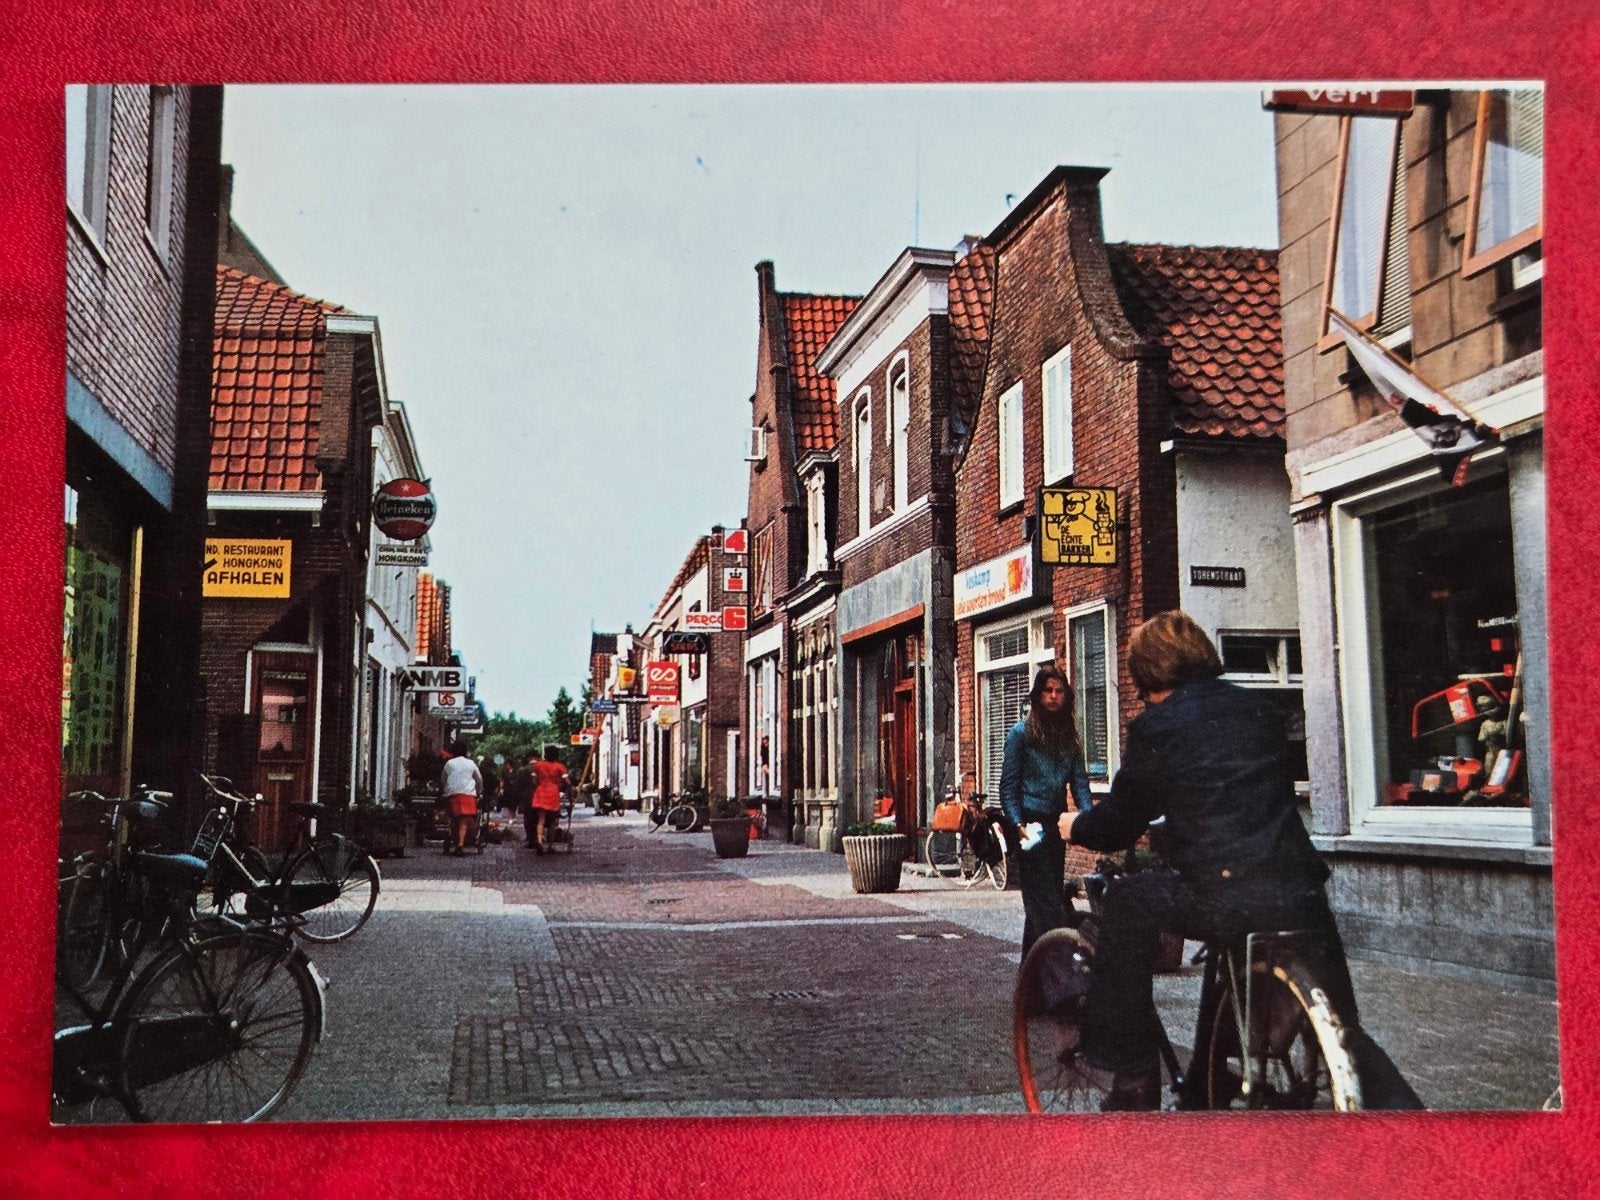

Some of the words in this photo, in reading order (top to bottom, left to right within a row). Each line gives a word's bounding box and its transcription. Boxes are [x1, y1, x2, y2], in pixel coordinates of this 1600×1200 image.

[380, 502, 430, 515] Heineken
[1060, 525, 1070, 534] DE
[725, 530, 746, 552] 4
[1060, 534, 1083, 545] ECHTE
[223, 545, 285, 556] RESTAURANT
[1060, 544, 1092, 555] BAKKER
[223, 558, 283, 569] HONGKONG
[378, 555, 427, 564] HONGKONG
[207, 571, 284, 585] AFHALEN
[1193, 569, 1243, 581] TORENSTRAAT
[724, 607, 746, 629] 6
[409, 670, 461, 686] NMB
